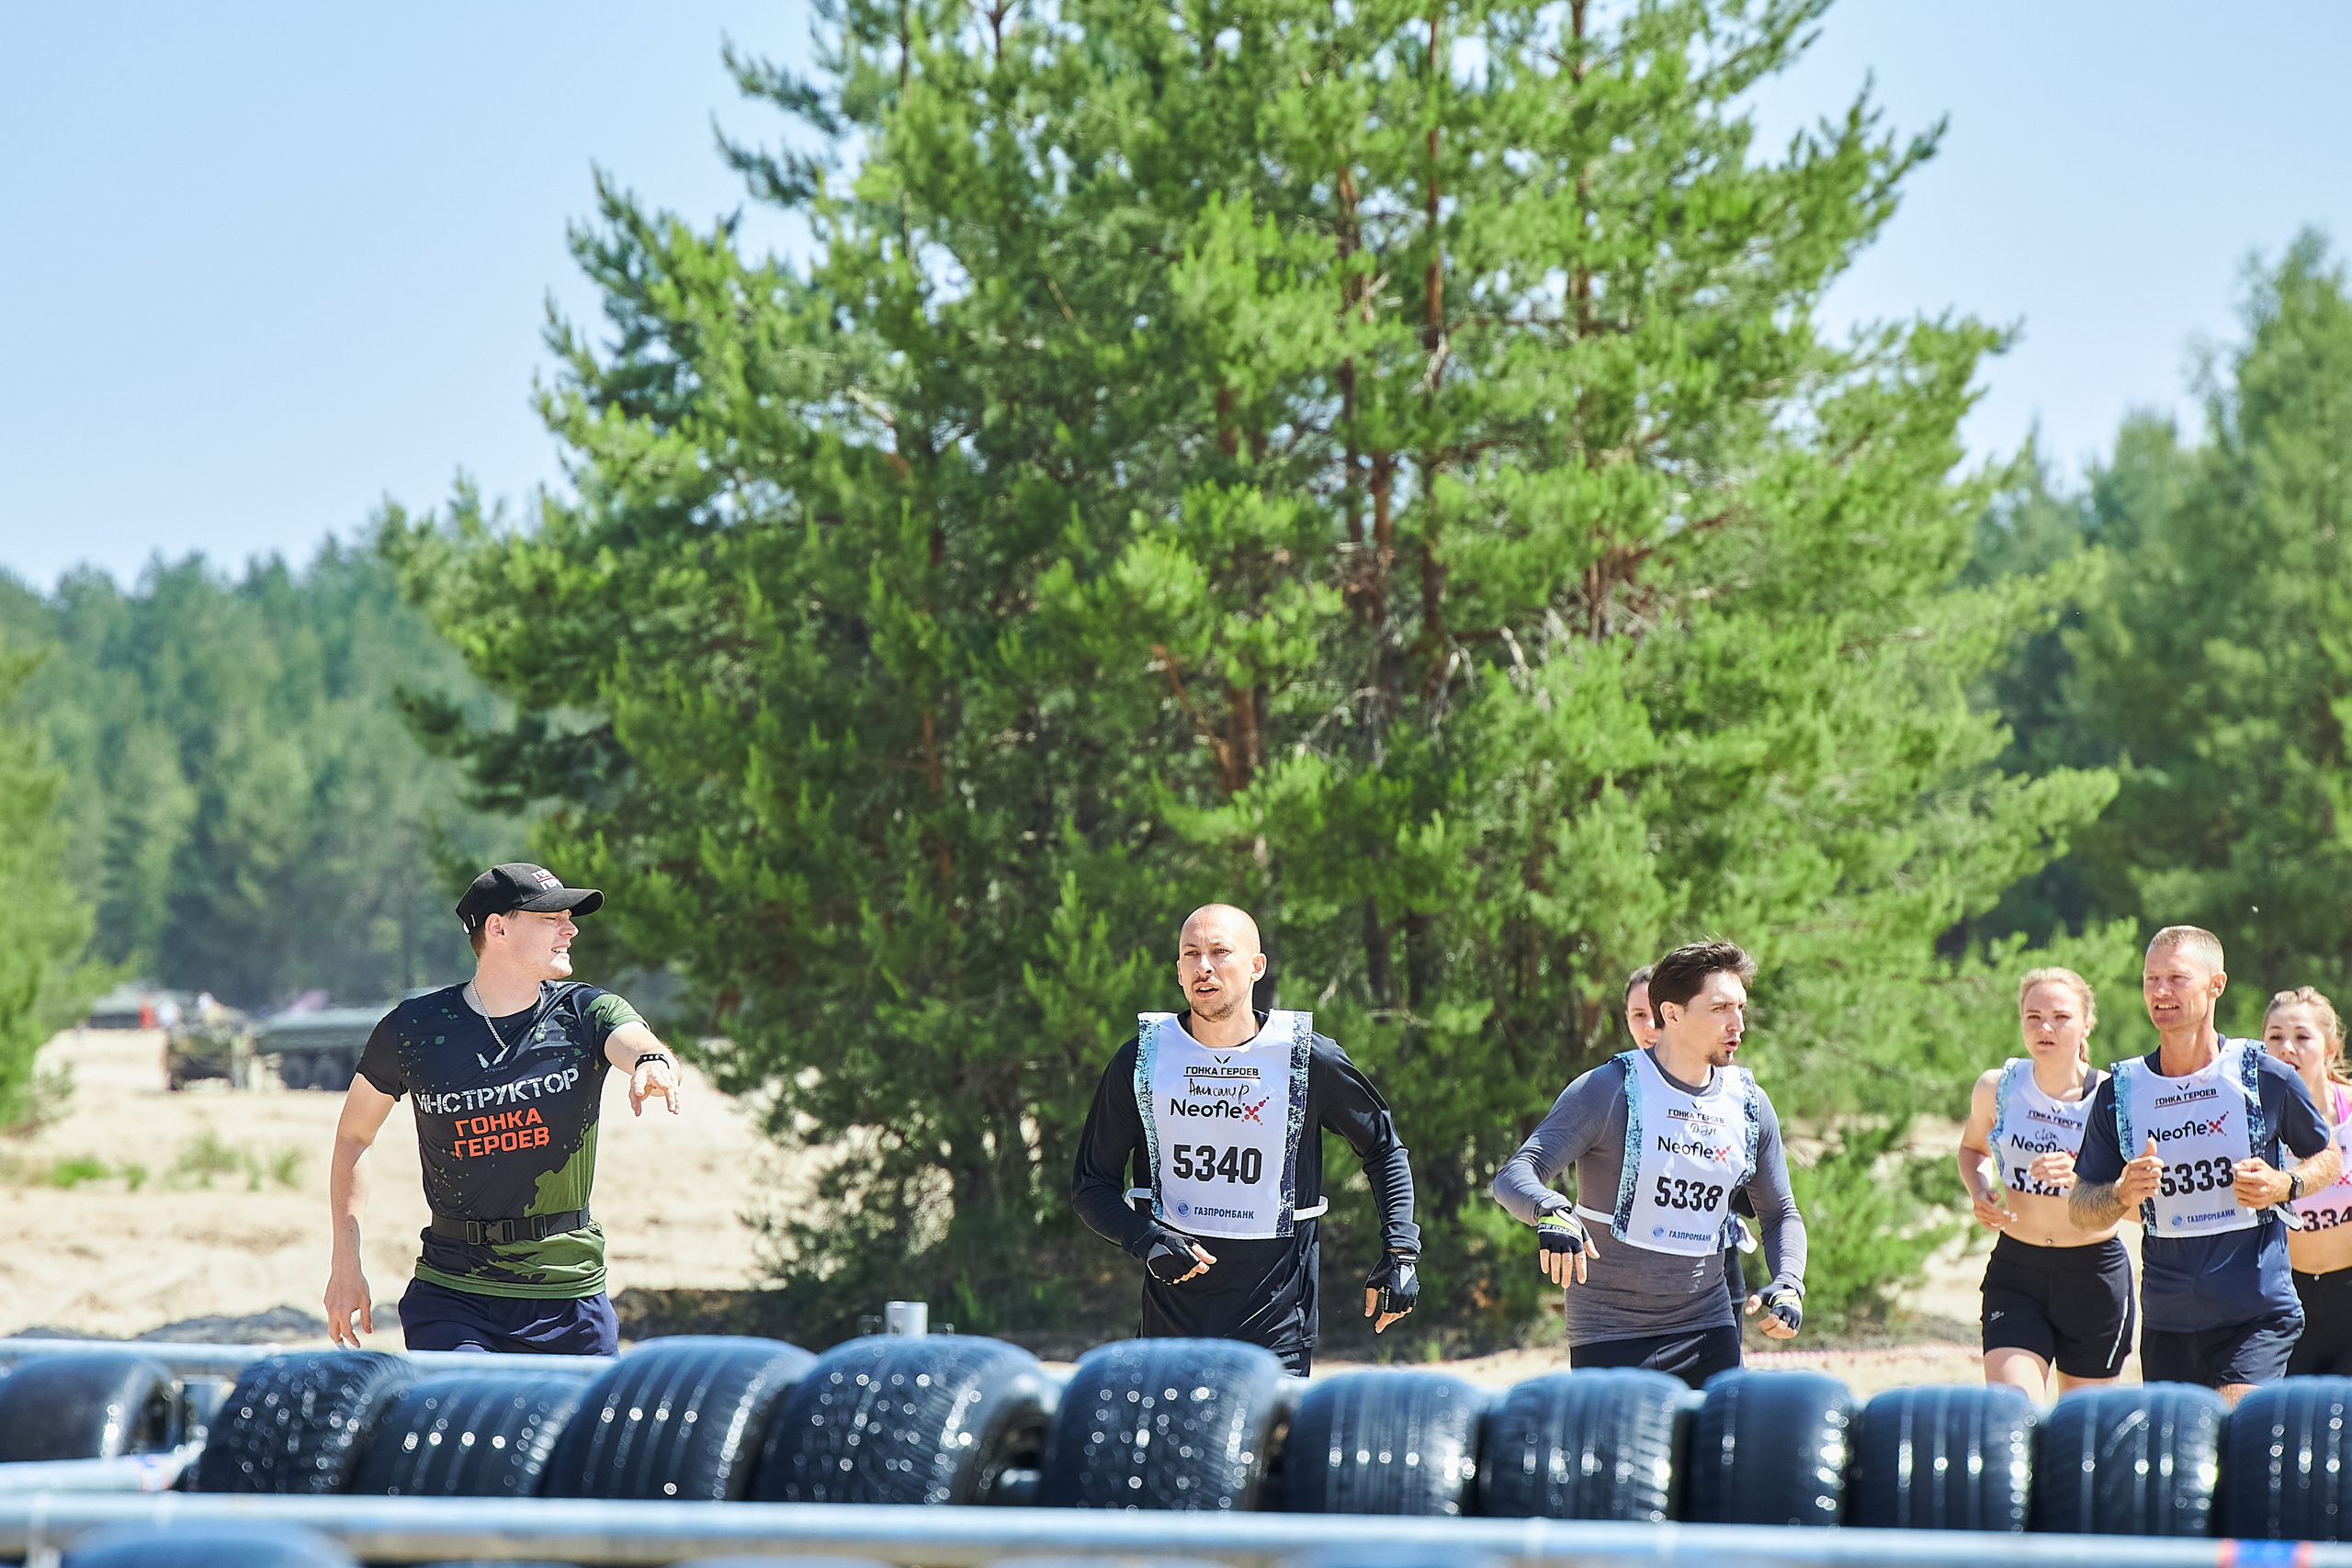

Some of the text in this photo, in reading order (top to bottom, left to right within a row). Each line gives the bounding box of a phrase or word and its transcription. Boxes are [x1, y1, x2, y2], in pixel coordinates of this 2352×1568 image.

[1185, 1066, 1259, 1077] ГОНКА ГЕРОЕВ
[415, 1067, 580, 1114] ИНСТРУКТОР
[2154, 1089, 2217, 1106] ГОНКА ГЕРОЕВ
[454, 1107, 543, 1137] ГОНКА
[1668, 1108, 1694, 1120] ГОНКА
[454, 1126, 550, 1159] ГЕРОЕВ
[1173, 1144, 1262, 1185] 5340
[2160, 1156, 2234, 1197] 5333
[1654, 1176, 1724, 1212] 5338
[1194, 1206, 1255, 1220] ГАЗПРОМБАНК
[2187, 1209, 2235, 1224] ГАЗПРОМБАНК
